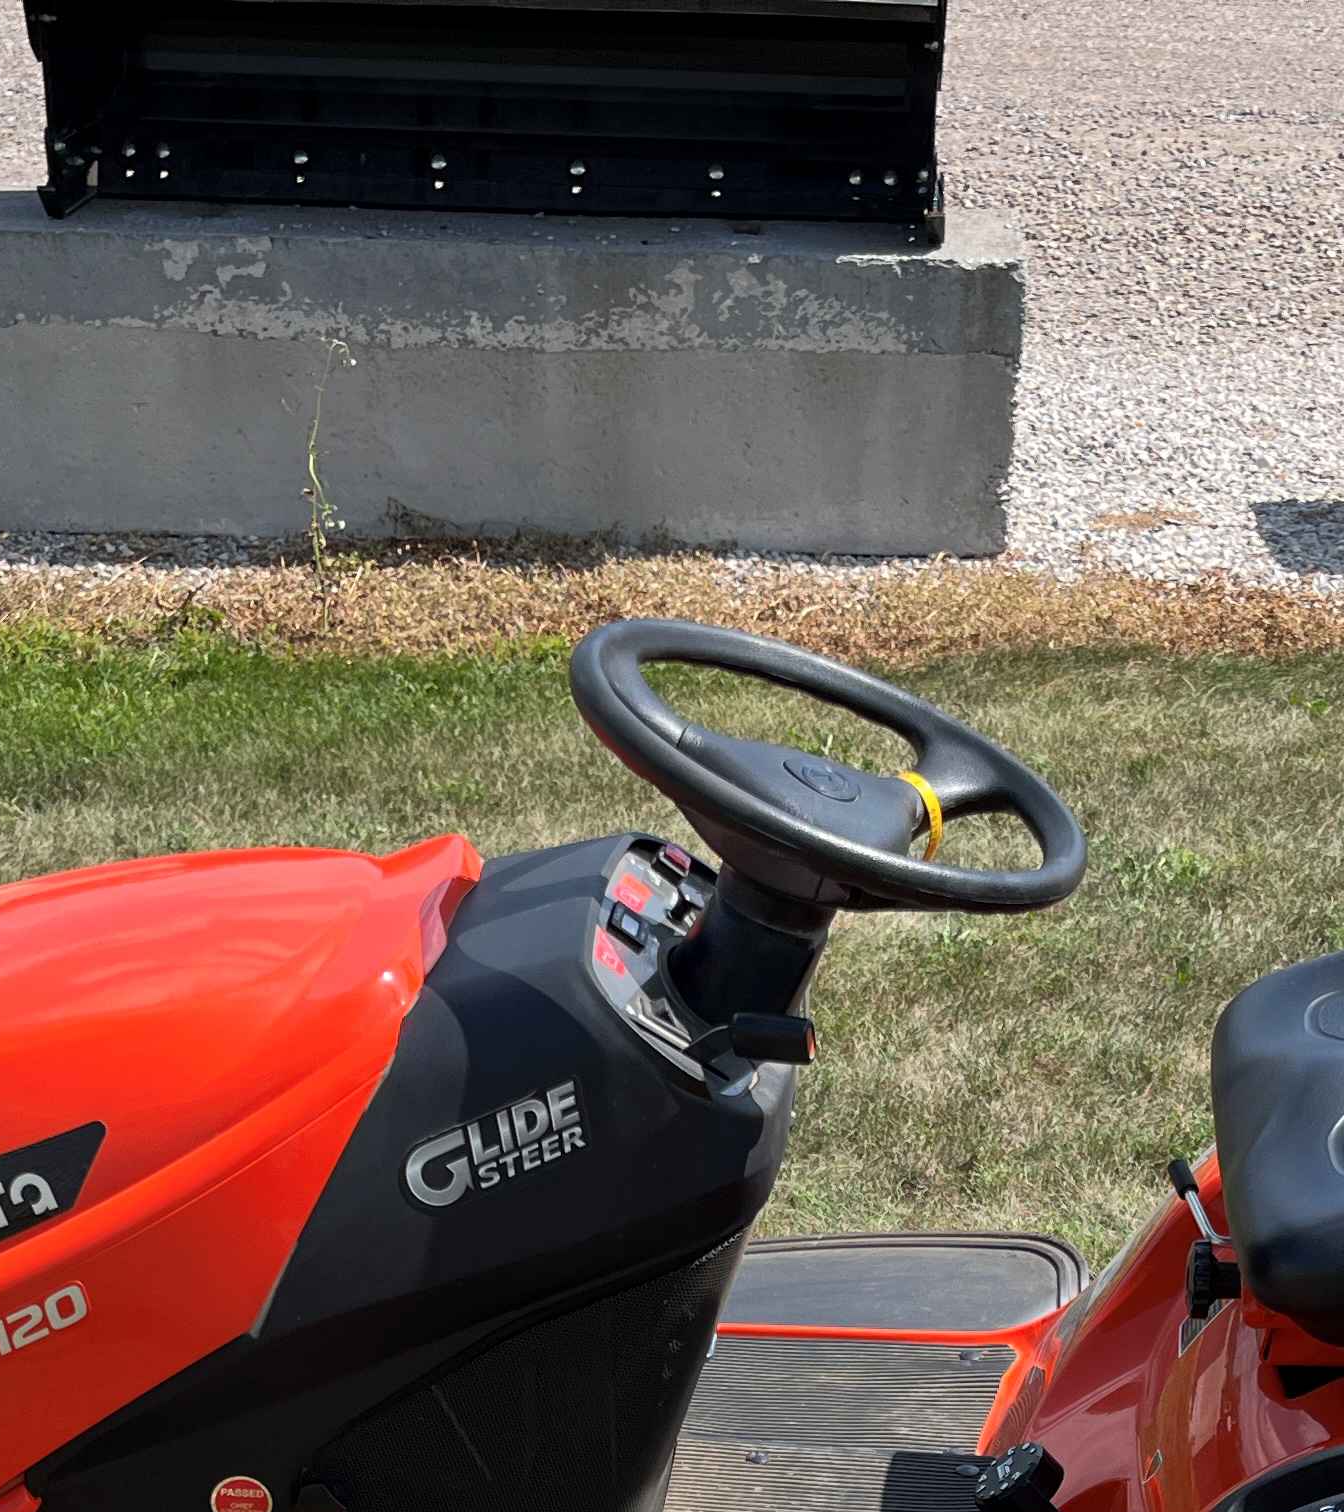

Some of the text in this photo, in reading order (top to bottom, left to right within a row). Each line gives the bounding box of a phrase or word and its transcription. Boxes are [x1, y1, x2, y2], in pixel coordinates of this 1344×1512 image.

[406, 1080, 581, 1207] GLIDE
[477, 1126, 587, 1189] STEER
[220, 1488, 264, 1498] PASSED
